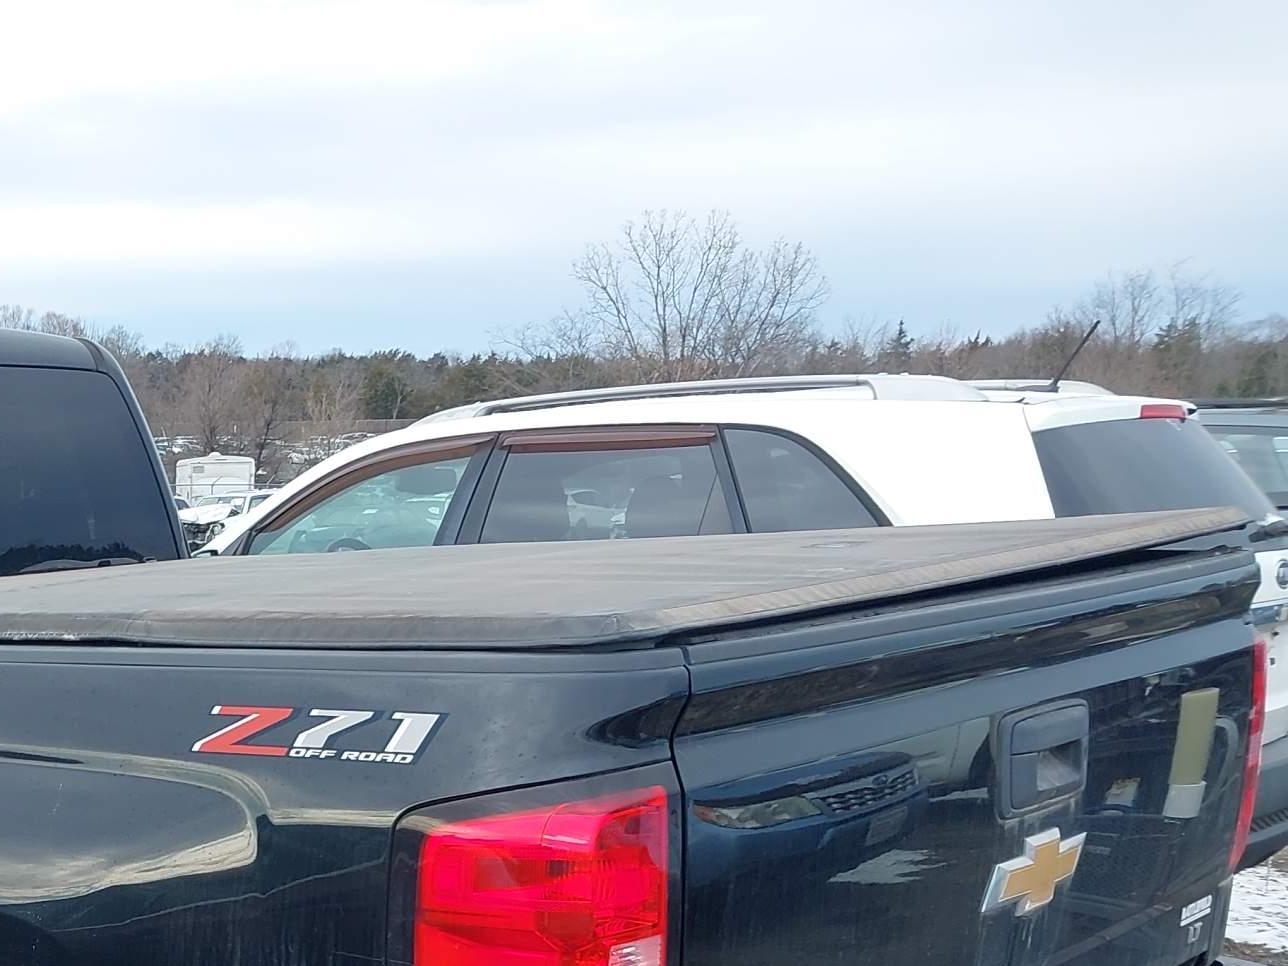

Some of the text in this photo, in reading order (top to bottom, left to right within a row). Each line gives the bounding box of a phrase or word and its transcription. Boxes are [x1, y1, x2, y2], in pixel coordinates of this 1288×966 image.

[191, 705, 443, 758] Z71
[288, 748, 415, 765] OFF ROAD
